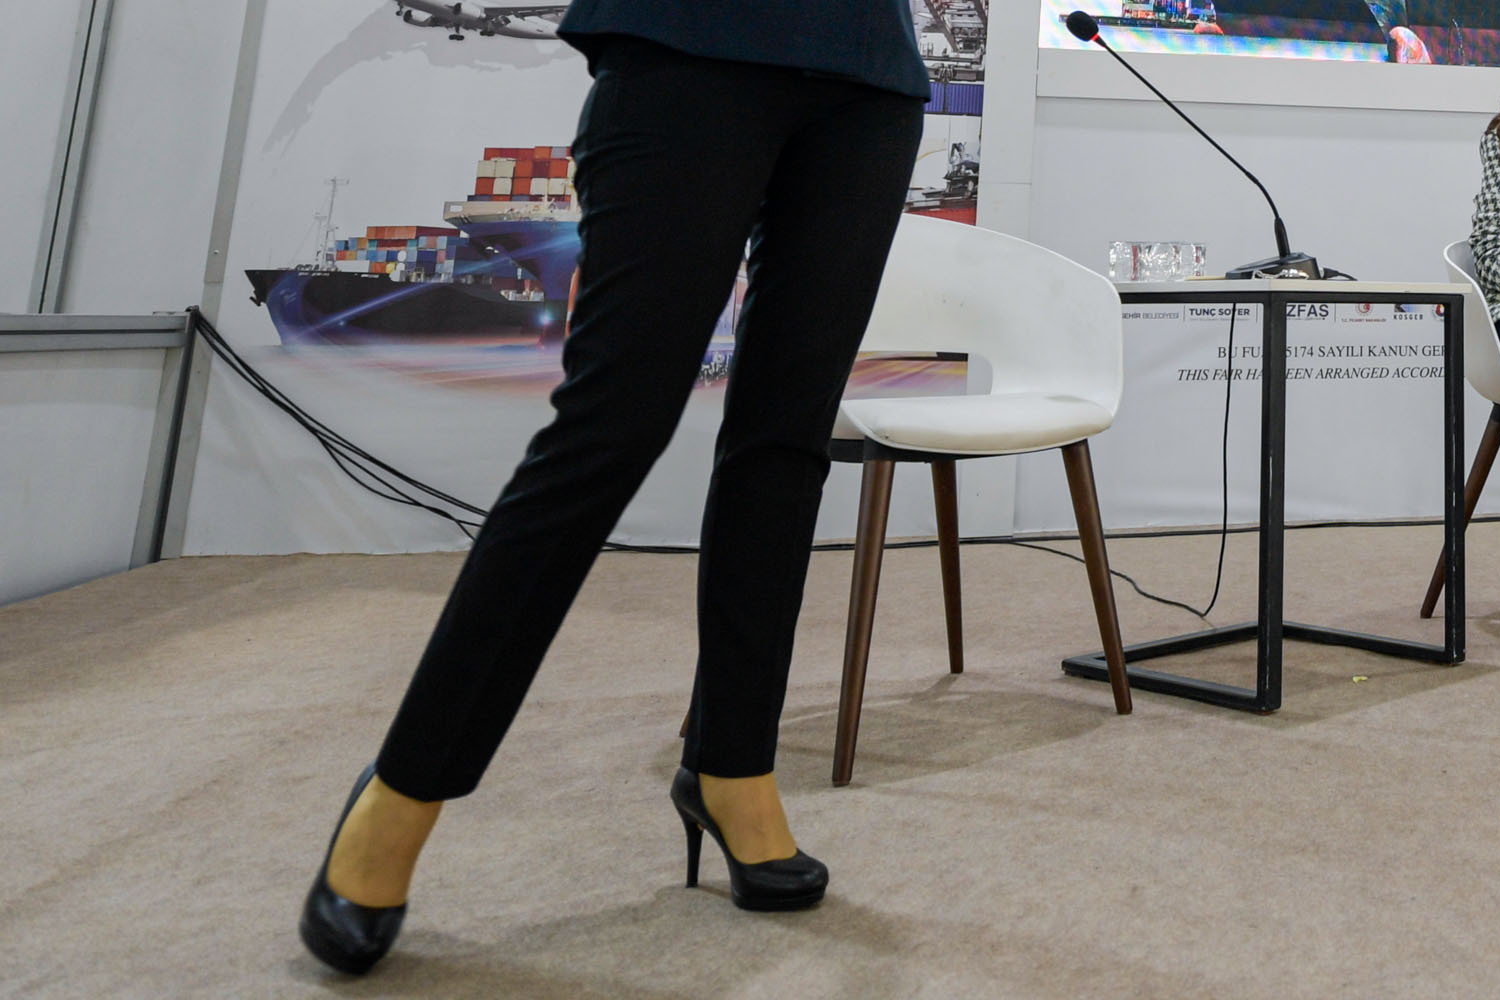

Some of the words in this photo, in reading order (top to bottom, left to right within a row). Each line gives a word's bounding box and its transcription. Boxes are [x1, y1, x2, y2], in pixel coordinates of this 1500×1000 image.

[1189, 308, 1215, 317] TUNÇ
[1242, 347, 1263, 358] FU
[1318, 346, 1363, 357] SAYILI
[1368, 345, 1418, 357] KANUN
[1178, 369, 1209, 381] THIS
[1212, 368, 1242, 381] FAIR
[1286, 368, 1313, 380] EEN
[1316, 367, 1389, 379] ARRANGED
